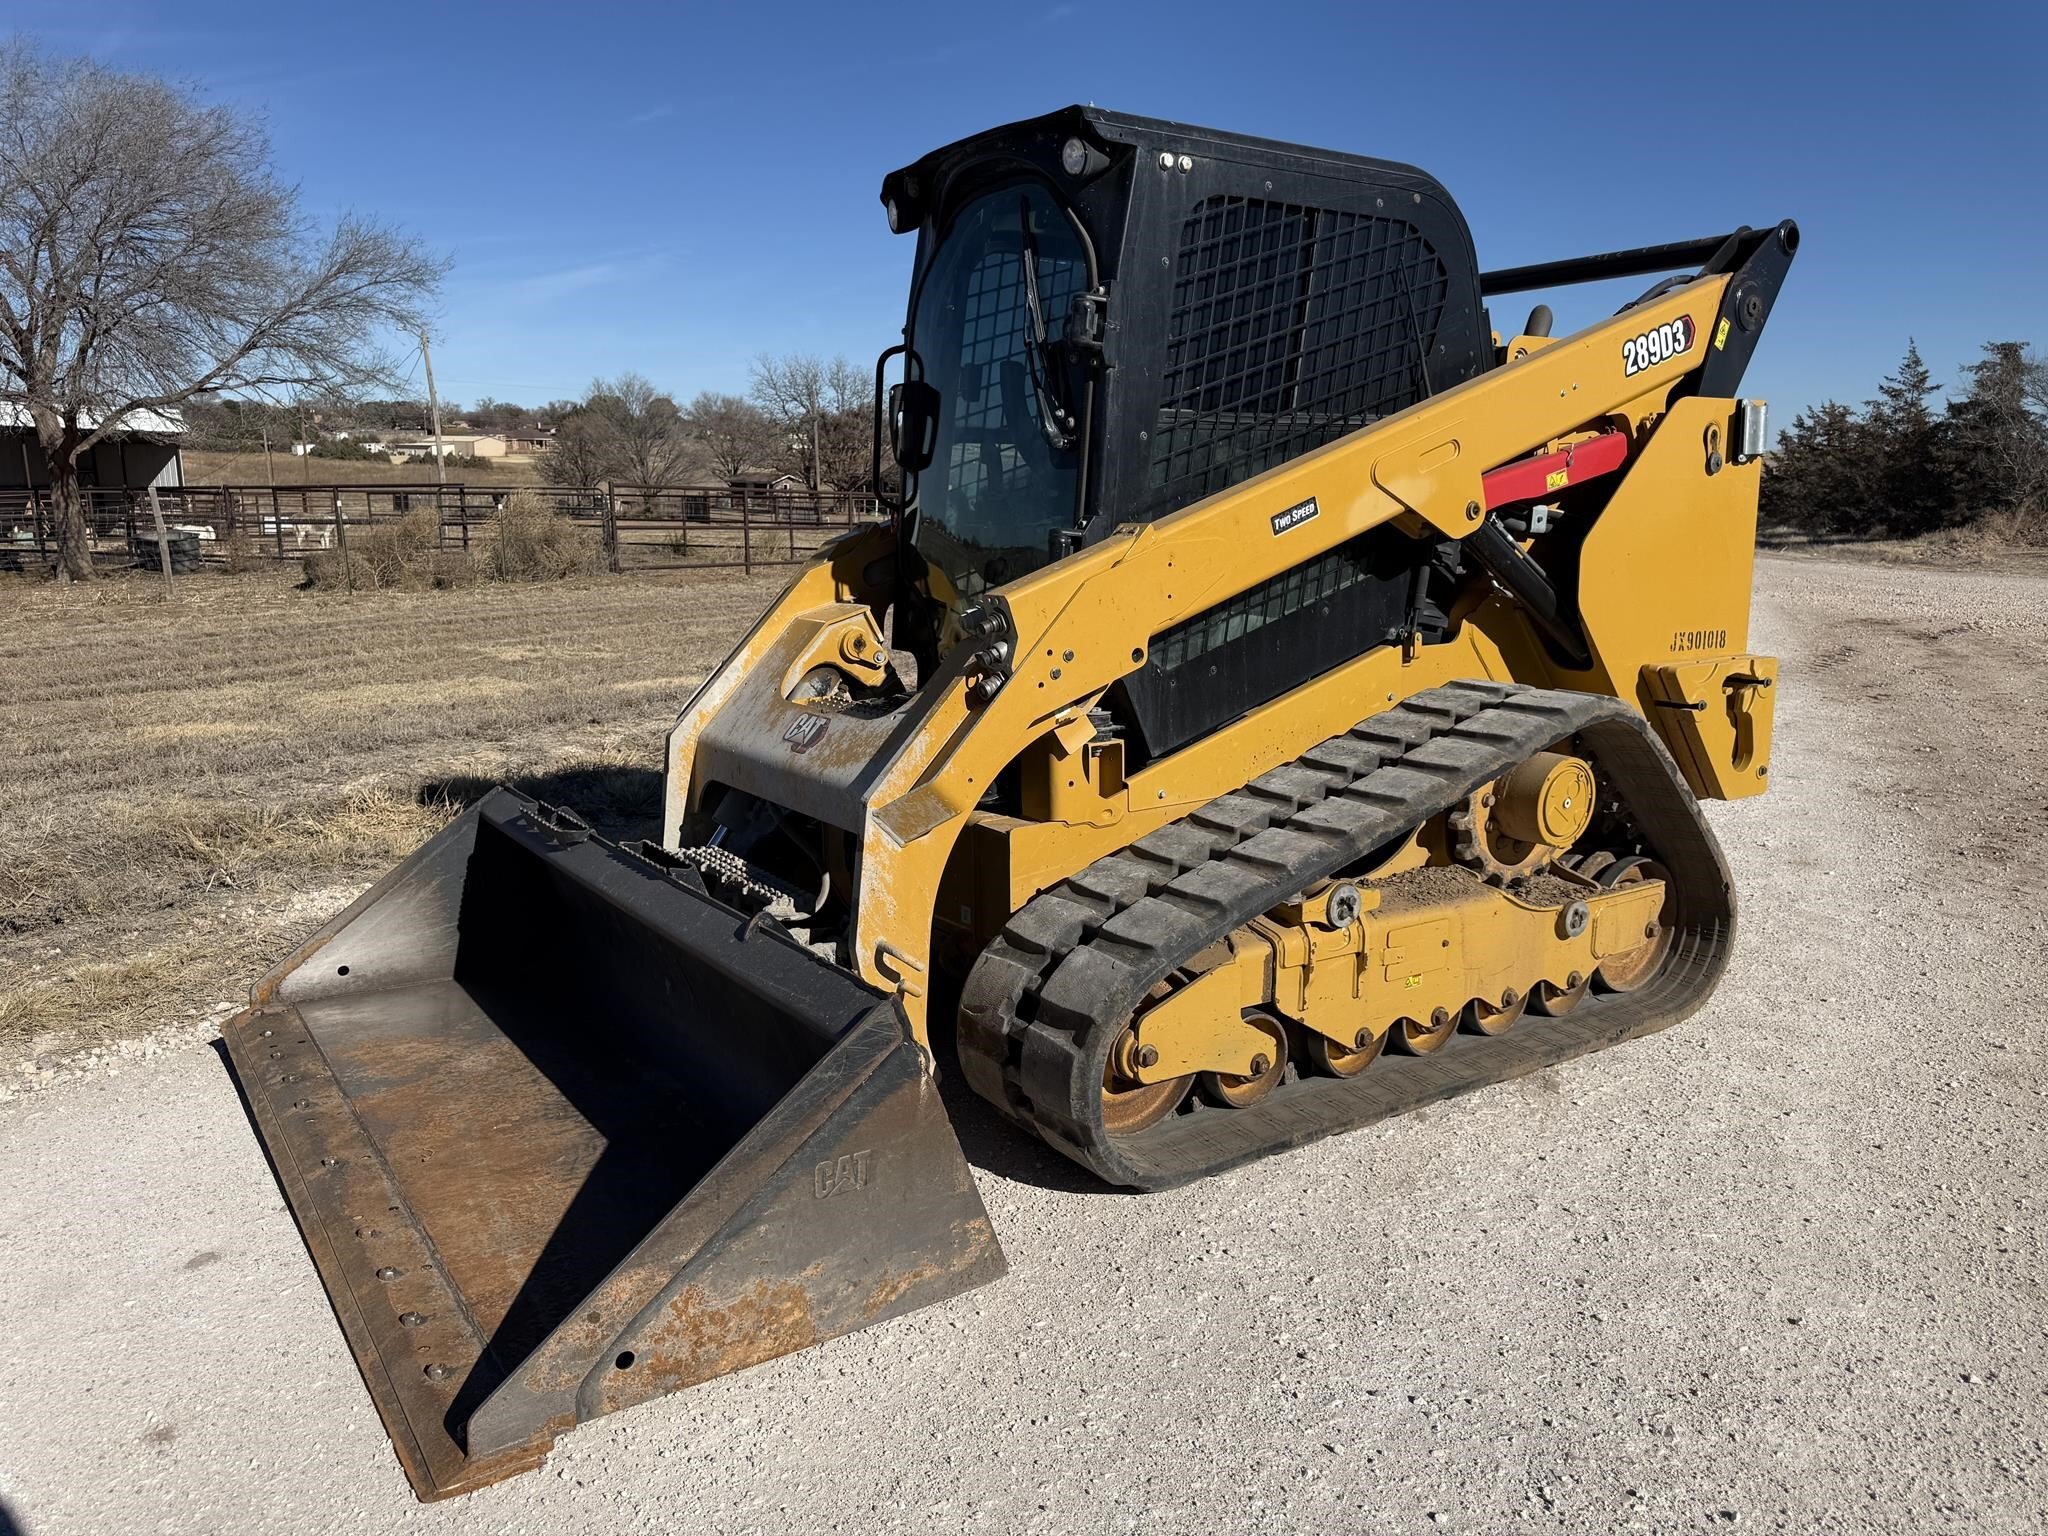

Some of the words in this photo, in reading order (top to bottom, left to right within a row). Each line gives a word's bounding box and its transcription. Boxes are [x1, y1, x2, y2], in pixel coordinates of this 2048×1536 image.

[1623, 318, 1687, 377] 289D3
[1669, 629, 1727, 652] JX901018
[783, 713, 828, 745] CAT
[814, 1149, 872, 1200] CAT
